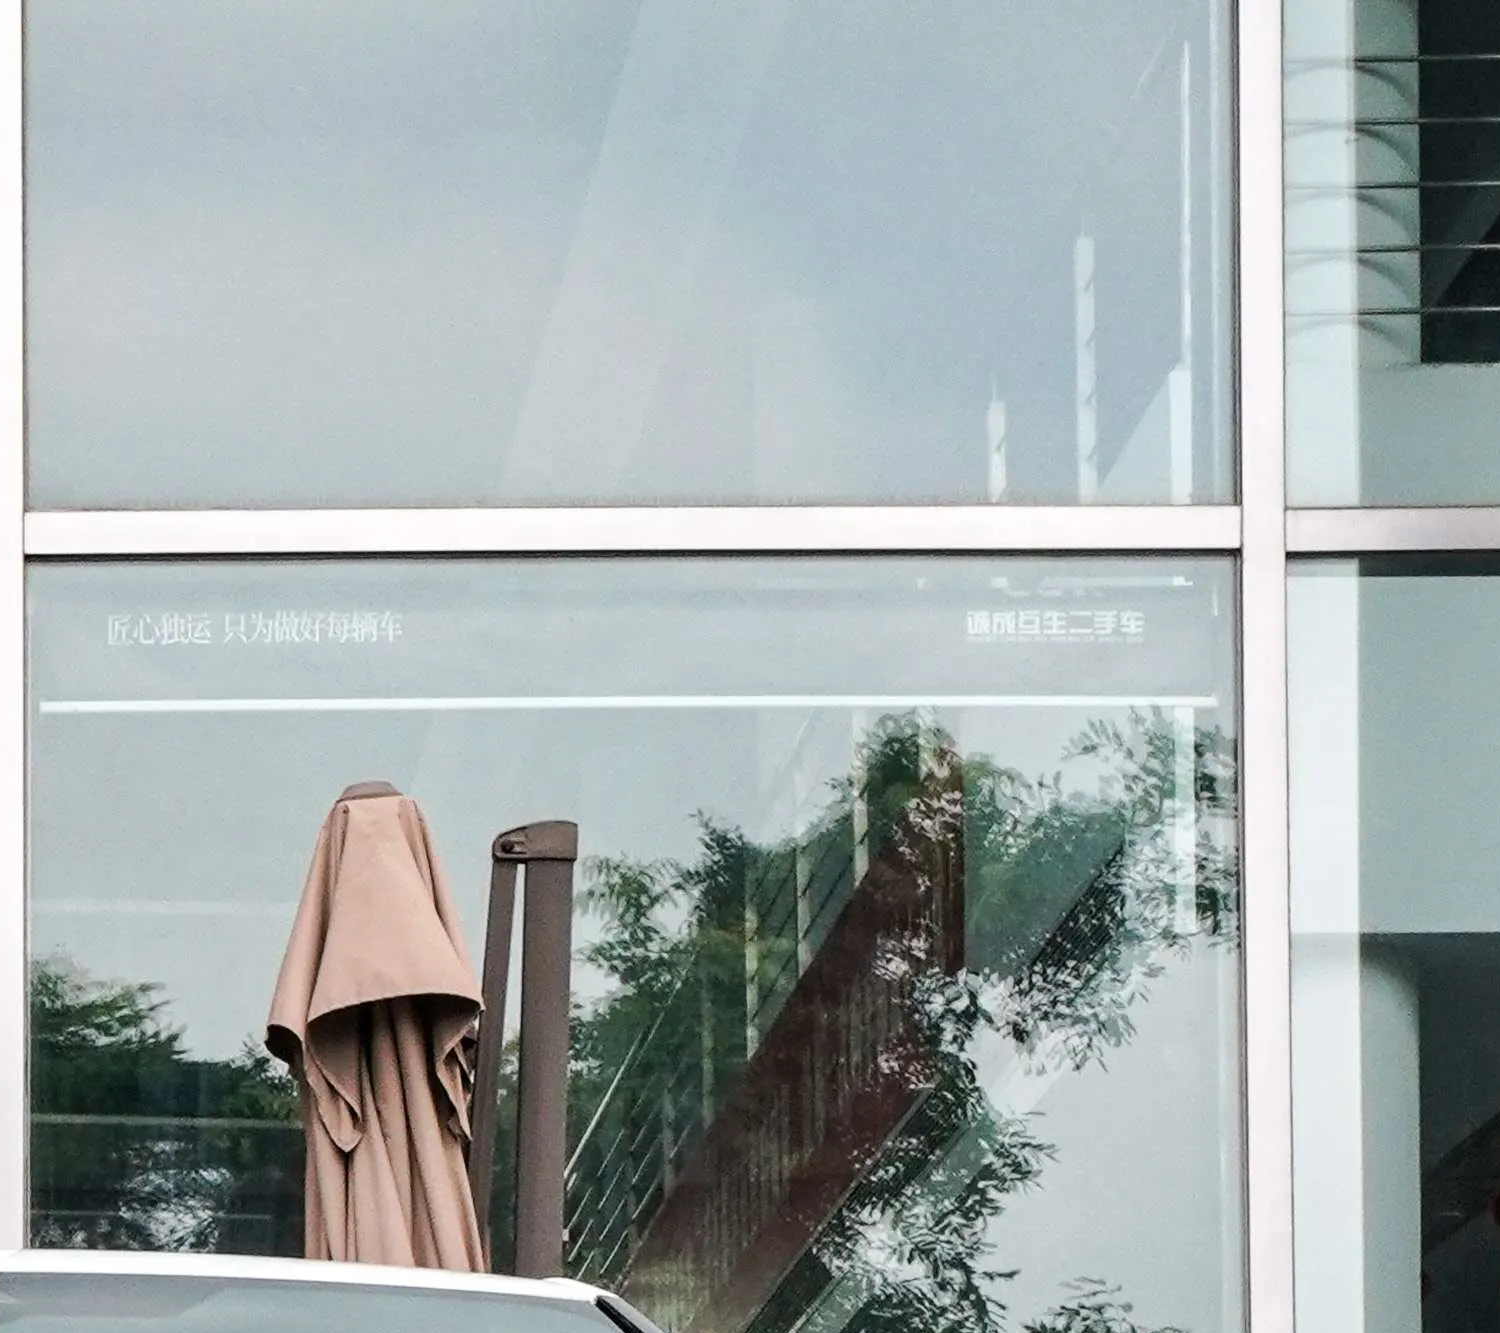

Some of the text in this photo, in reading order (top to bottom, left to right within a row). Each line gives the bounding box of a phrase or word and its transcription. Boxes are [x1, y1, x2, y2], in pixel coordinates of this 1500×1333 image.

[107, 610, 403, 646] 匠心独运 只为做好每辆车
[966, 609, 1145, 635] 诚成互生二手车
